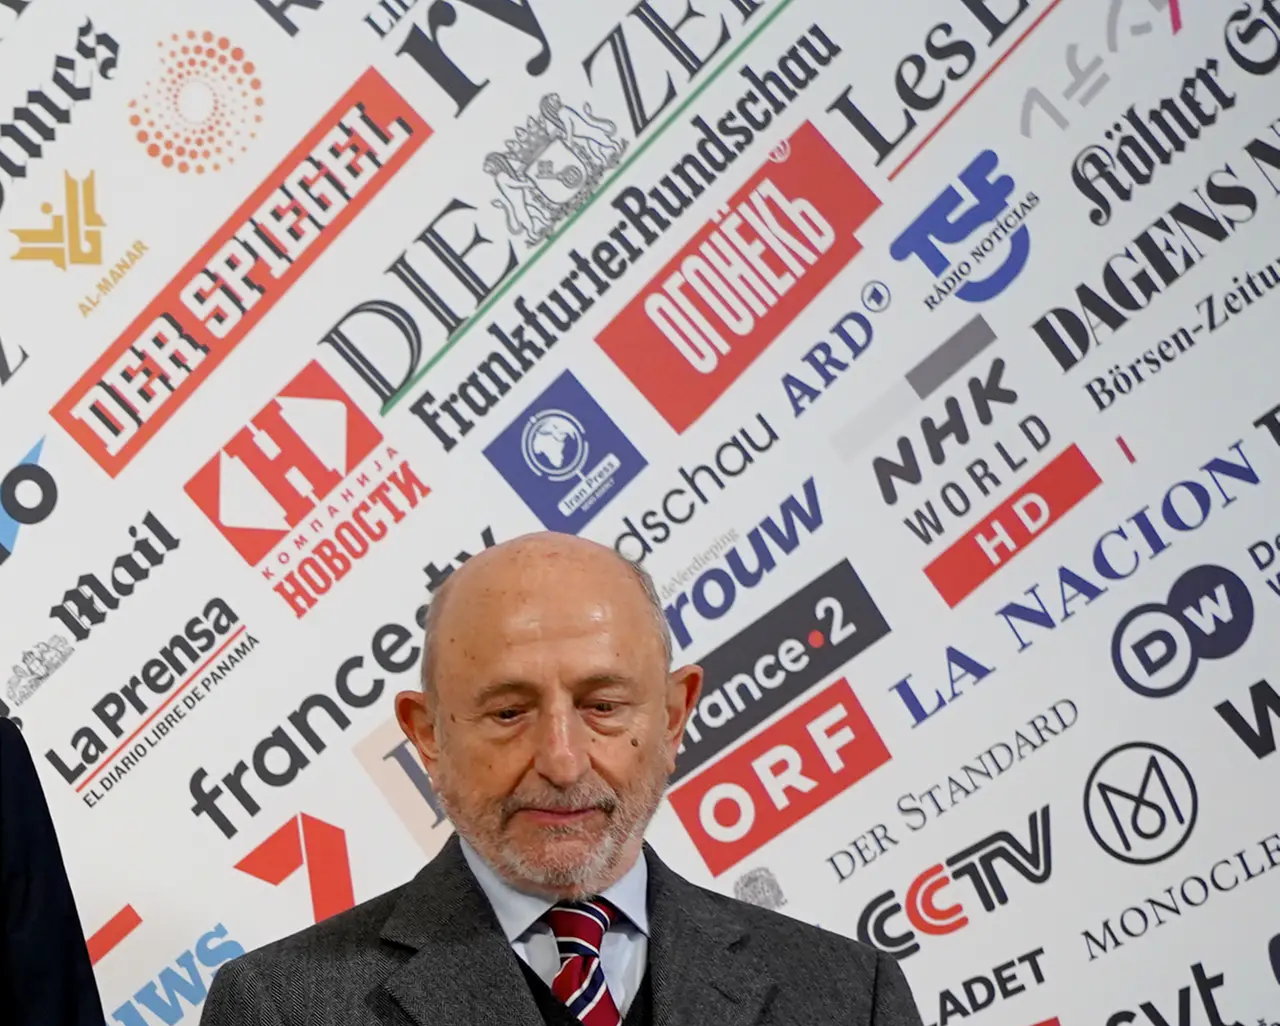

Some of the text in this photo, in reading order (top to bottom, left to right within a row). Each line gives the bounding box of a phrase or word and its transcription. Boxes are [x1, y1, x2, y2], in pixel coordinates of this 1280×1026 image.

[826, 22, 977, 168] Les
[1071, 58, 1237, 227] Kölner
[317, 0, 763, 409] DIE ZE
[923, 191, 1041, 313] RÁDIO NOTÍCIAS
[1030, 162, 1259, 374] DAGENS
[69, 100, 415, 457] DER SPIEGEL
[77, 239, 150, 319] AL-MANAR
[780, 311, 875, 418] ARD
[872, 357, 1018, 506] NHK
[273, 460, 432, 620] НОВОСТИ
[903, 413, 1052, 546] WORLD
[973, 492, 1051, 568] HD
[49, 511, 182, 643] Mail
[888, 439, 1262, 731] LA NACION
[83, 632, 261, 808] EL DIARIO LIBRE DE PANAMÁ
[92, 597, 240, 741] Prensa
[677, 638, 811, 755] rance
[698, 703, 857, 844] ORF
[825, 698, 1080, 885] DER STANDARD
[856, 803, 1052, 963] CCTV
[1080, 833, 1280, 962] MONOCLE
